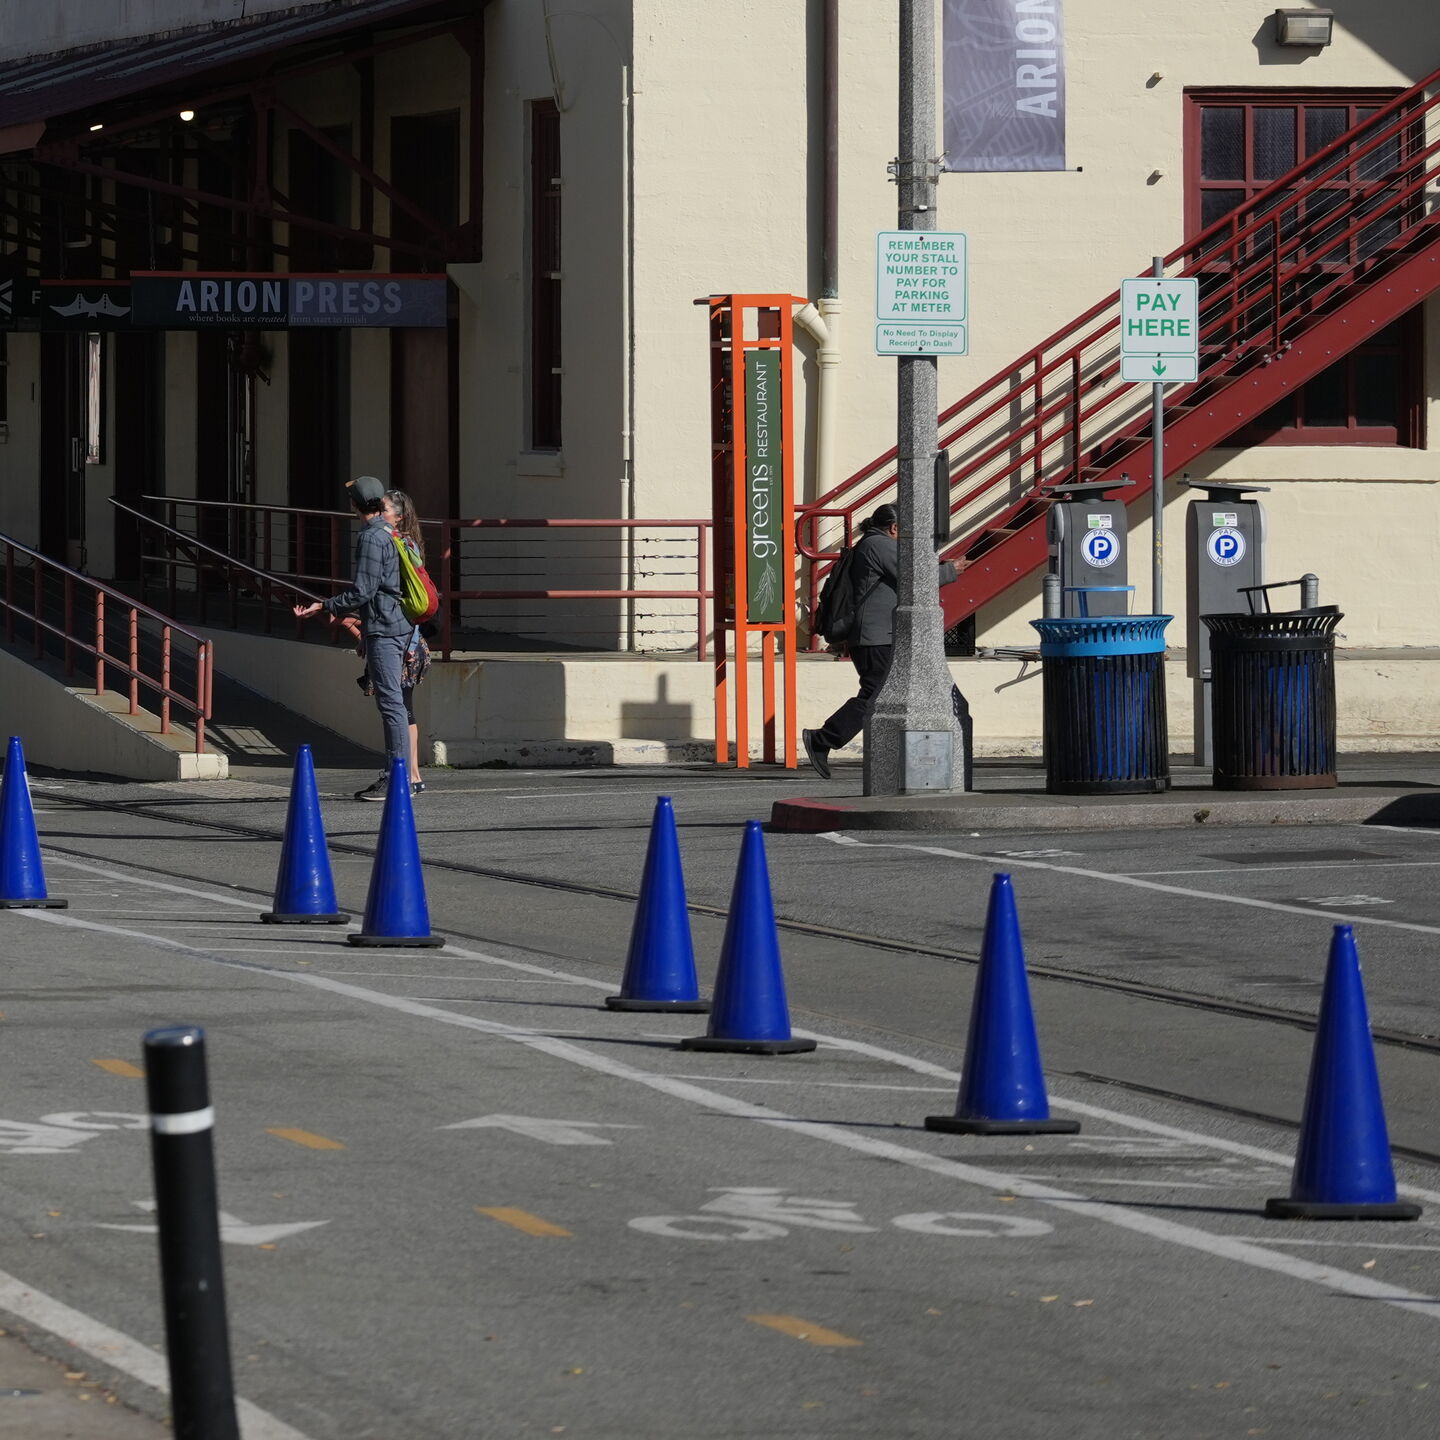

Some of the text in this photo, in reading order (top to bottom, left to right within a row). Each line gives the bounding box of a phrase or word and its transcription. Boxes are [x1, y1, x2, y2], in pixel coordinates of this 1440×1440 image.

[888, 241, 955, 251] REMEMBER
[885, 253, 959, 263] YOUR STALL
[886, 265, 958, 276] NUMBER TO
[896, 278, 946, 288] PAY FOR
[176, 280, 402, 314] ARION PRESS
[895, 290, 949, 300] PARKING
[1136, 293, 1181, 311] PAY
[892, 303, 951, 312] AT METER
[187, 314, 214, 323] where
[216, 314, 241, 323] books
[257, 314, 287, 323] created
[1128, 318, 1191, 337] HERE
[883, 329, 959, 339] No Need To Display
[889, 339, 953, 348] Receipt On Dash
[752, 361, 777, 559] greens RESTAURANT
